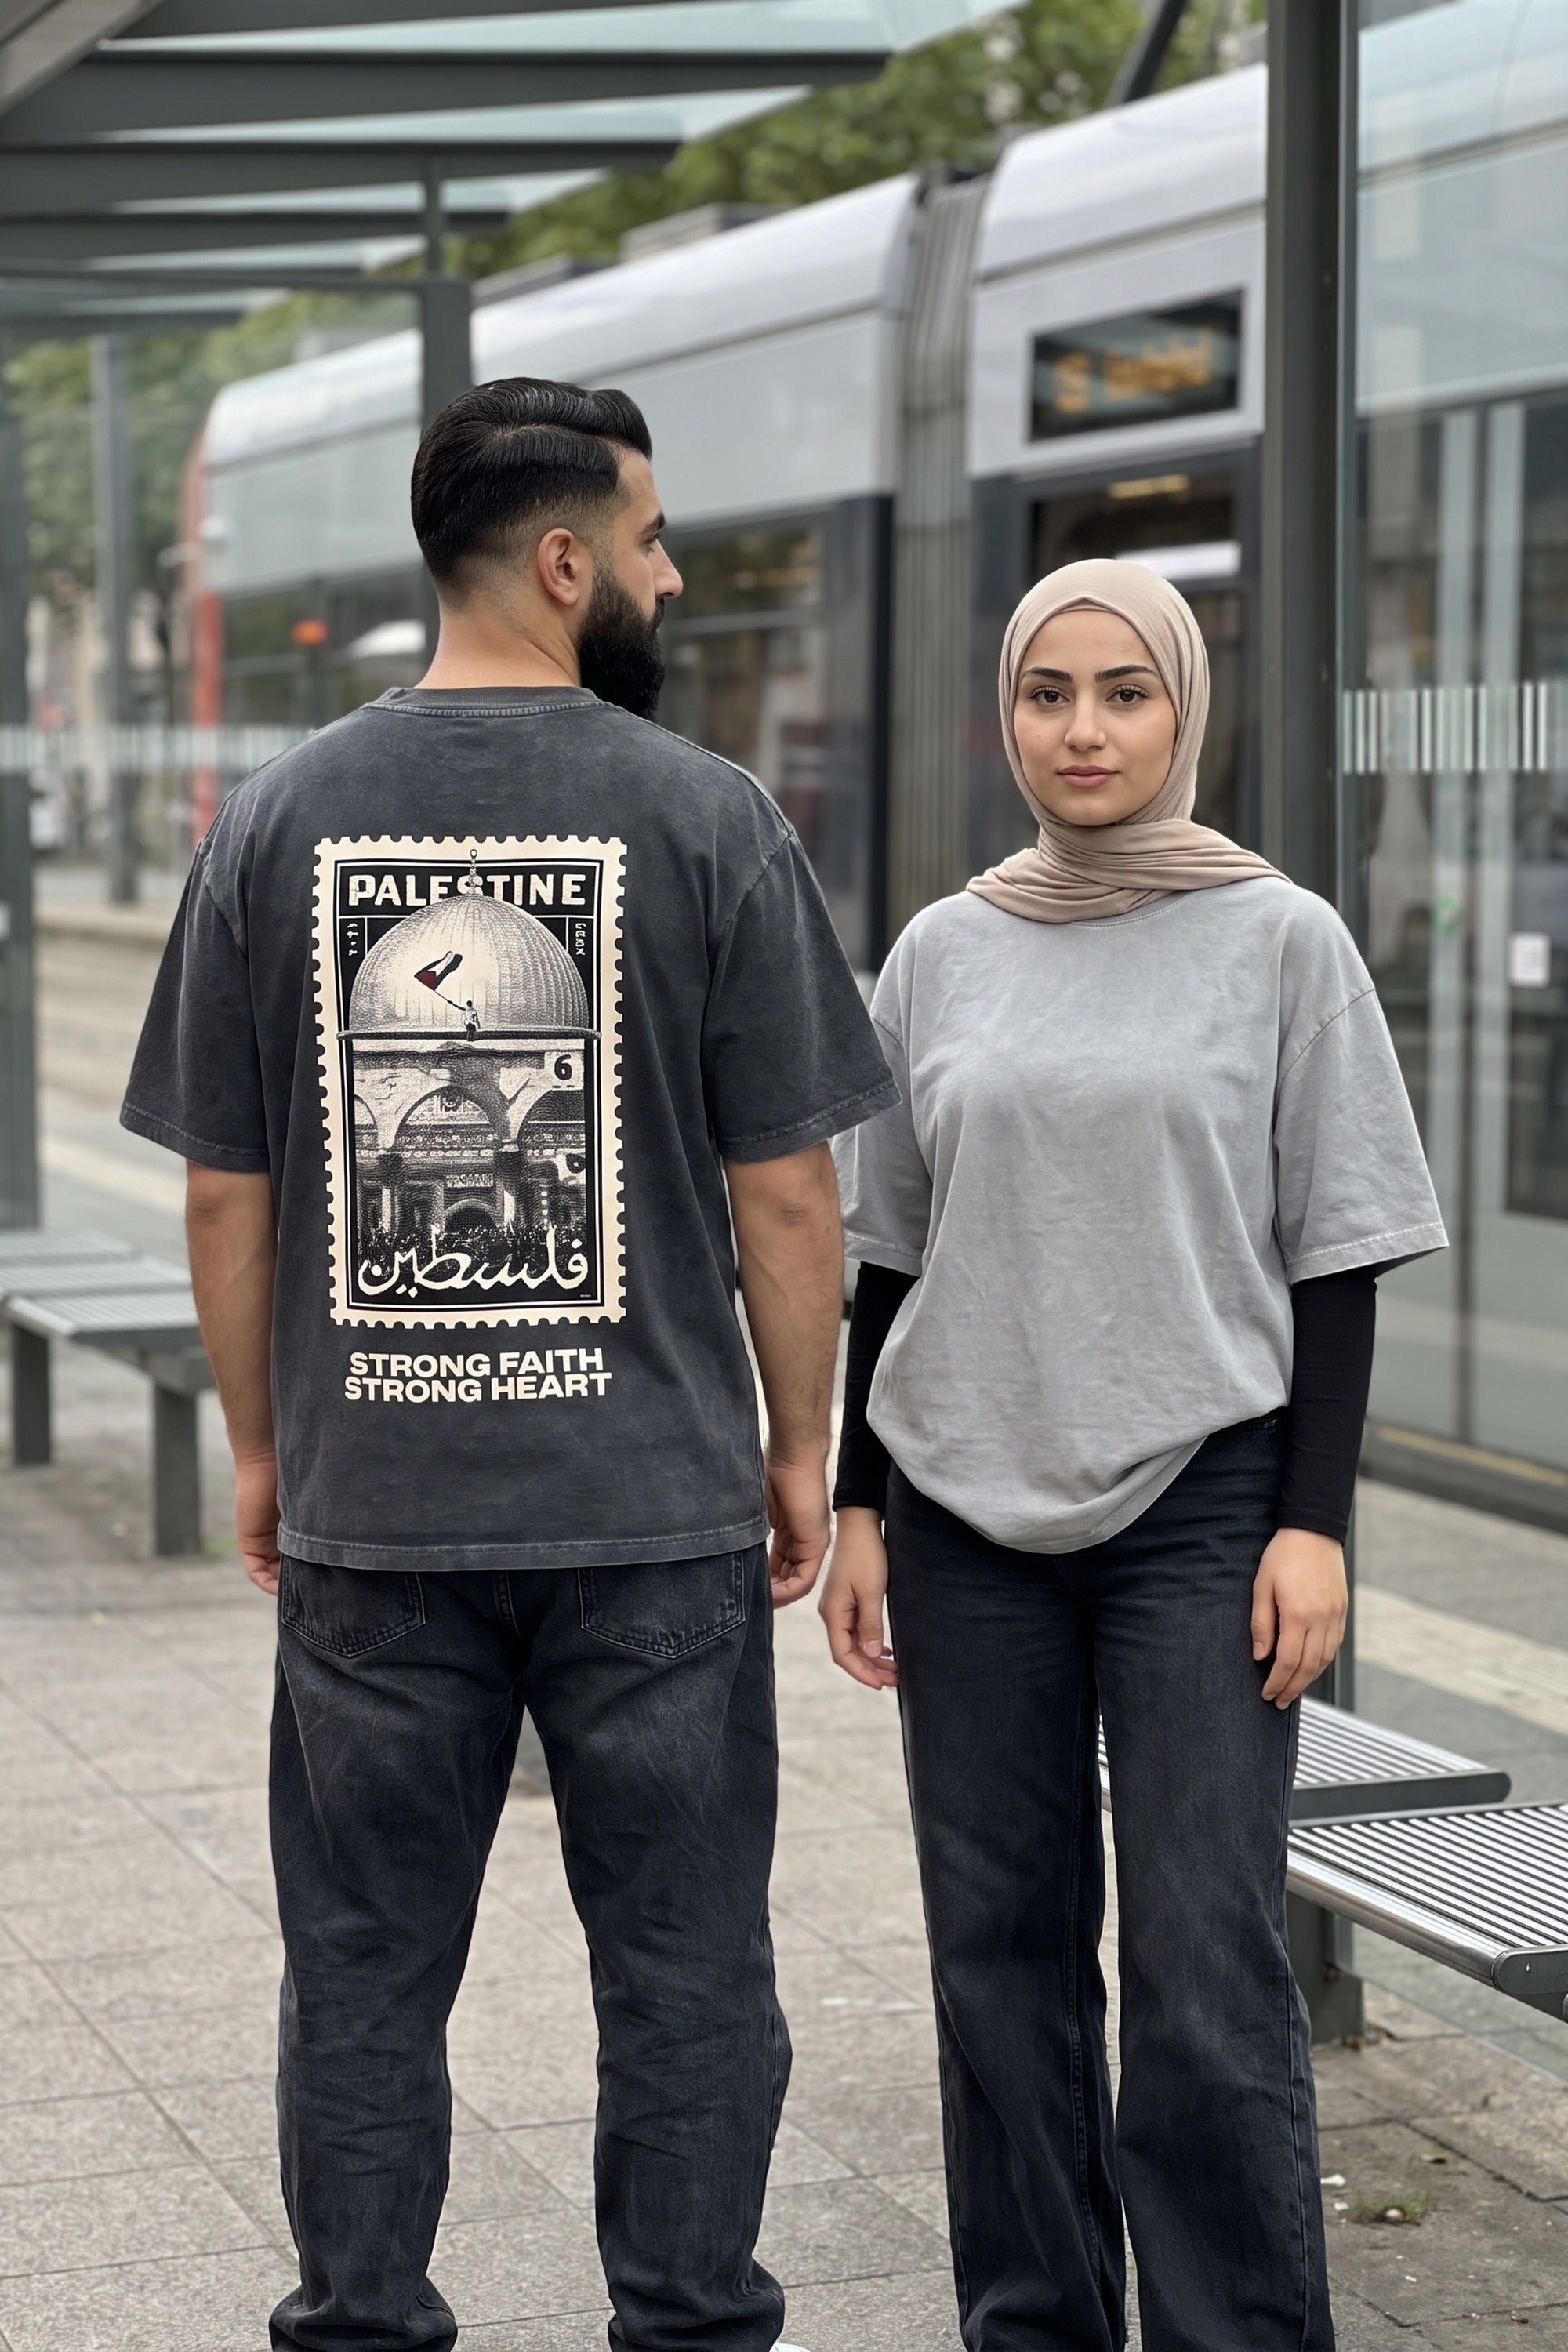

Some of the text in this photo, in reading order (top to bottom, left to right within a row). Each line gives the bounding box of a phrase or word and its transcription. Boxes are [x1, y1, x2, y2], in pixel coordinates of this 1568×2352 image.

[348, 874, 586, 906] PALESTINE
[554, 1054, 572, 1080] 6
[358, 1222, 588, 1298] فلسطين
[350, 1348, 604, 1377] STRONG FAITH
[344, 1372, 612, 1403] STRONG HEART
